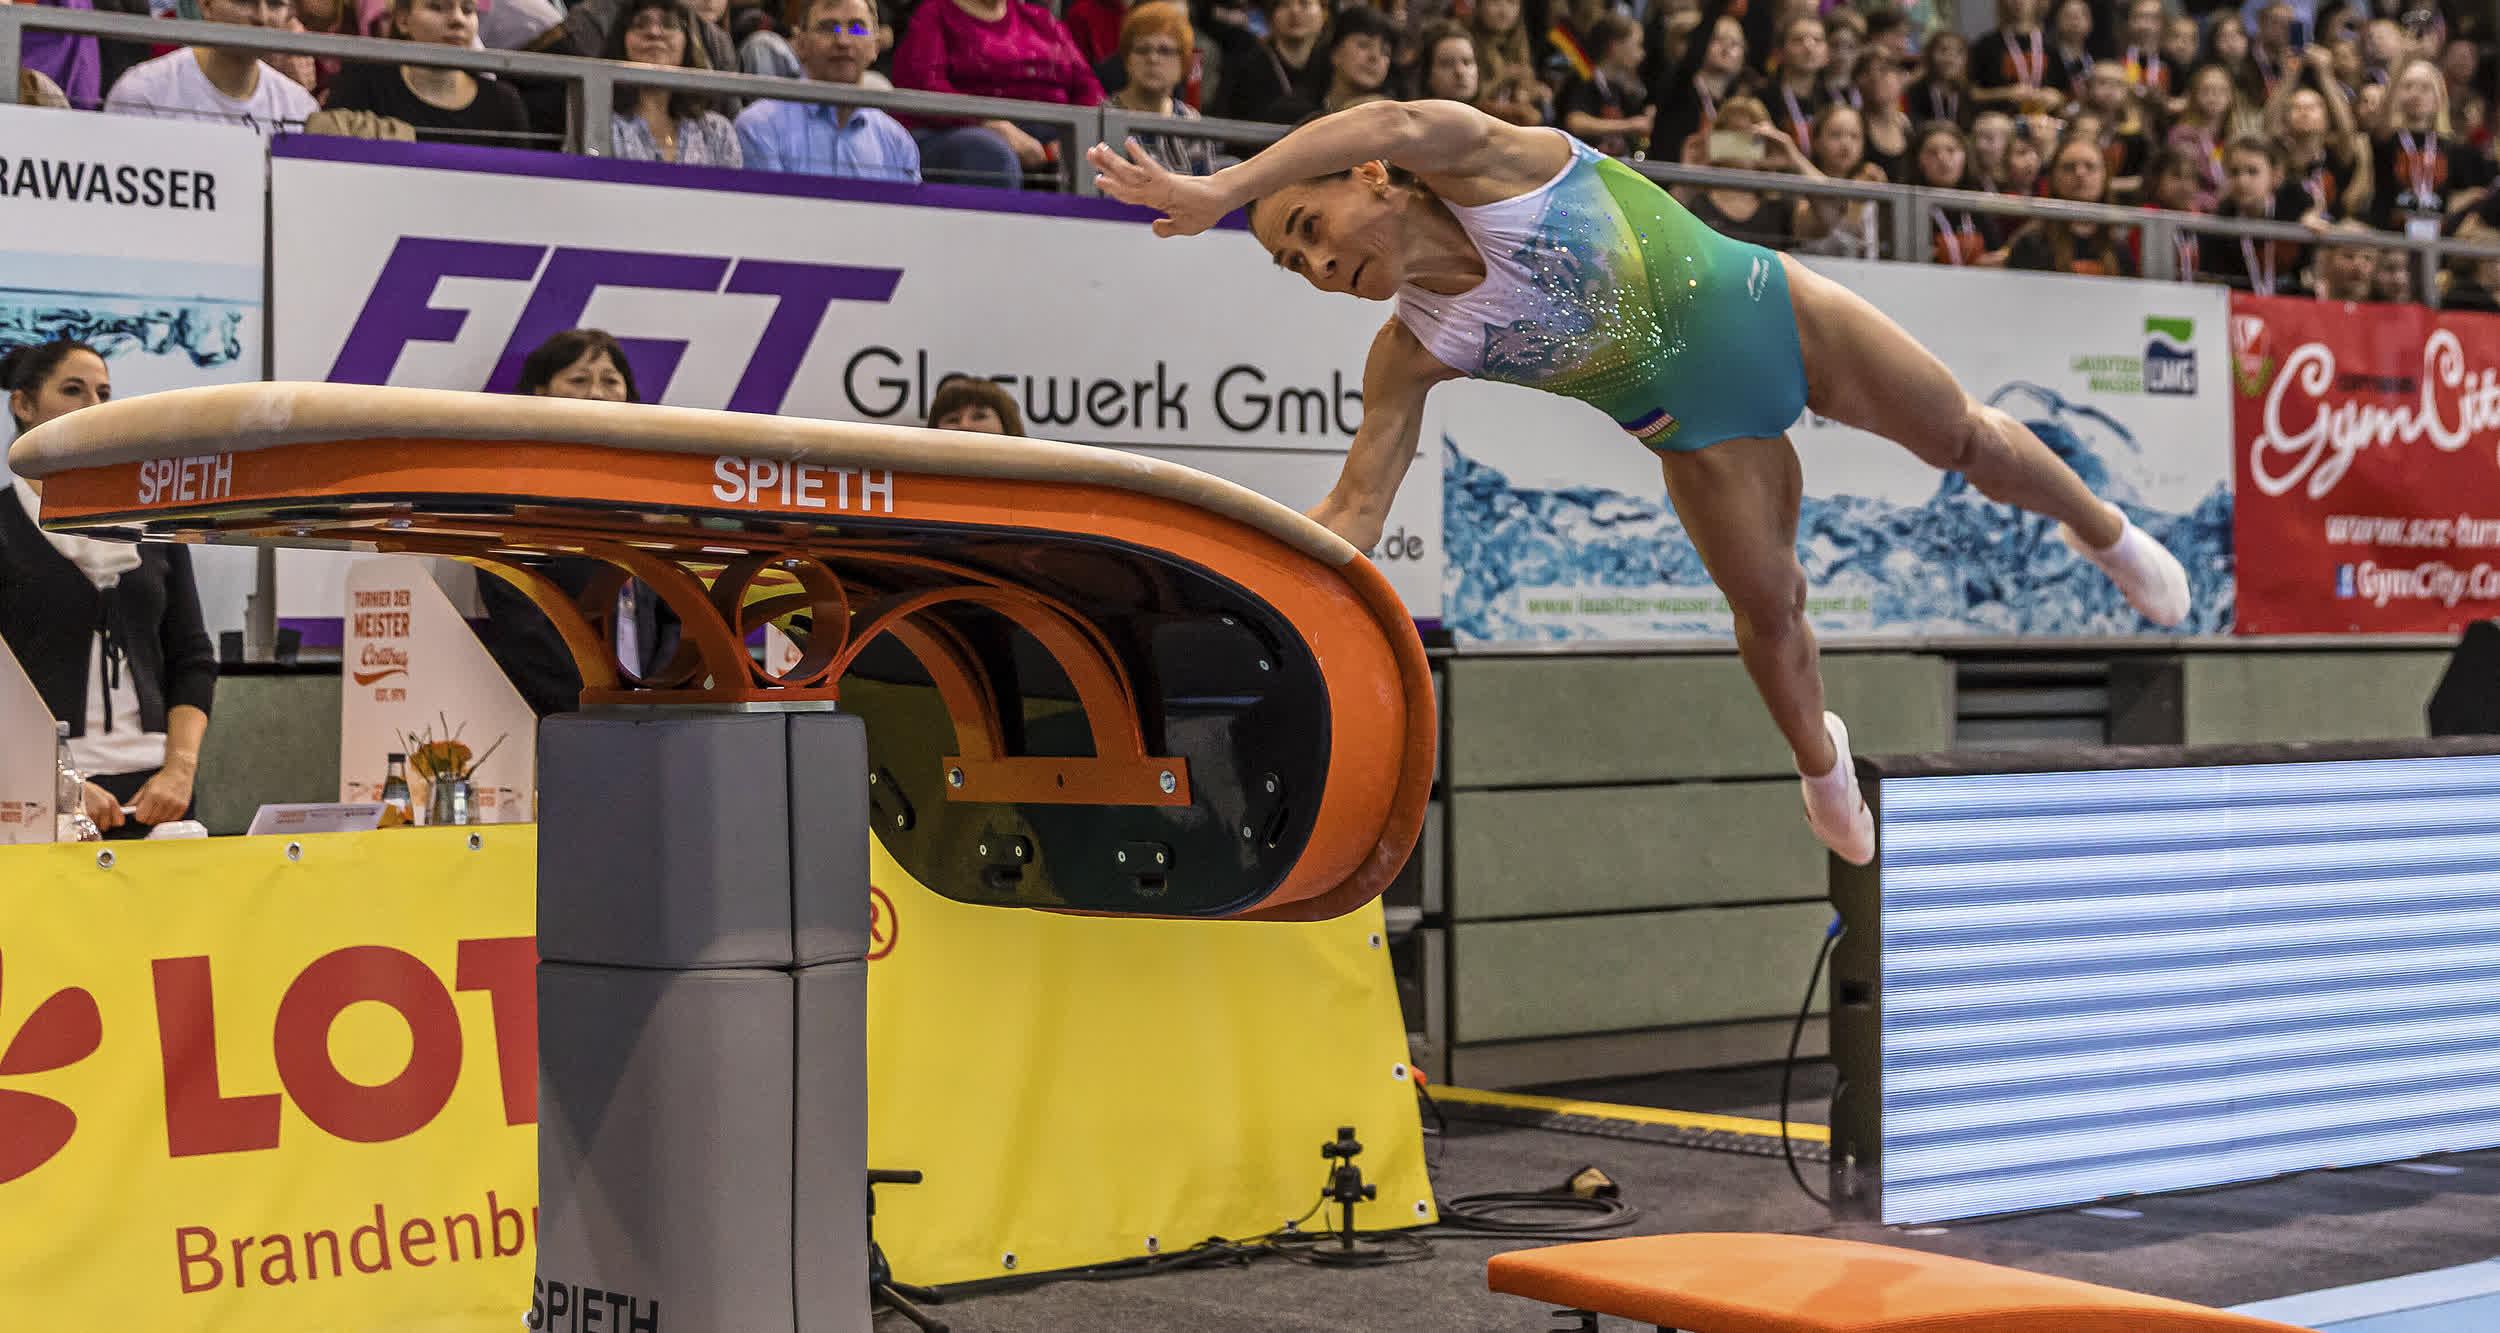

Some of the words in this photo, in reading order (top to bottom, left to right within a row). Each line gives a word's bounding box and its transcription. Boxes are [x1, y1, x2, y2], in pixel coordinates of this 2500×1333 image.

[842, 345, 1190, 429] Glwerk
[2250, 328, 2500, 500] GymCit
[139, 452, 232, 504] SPIETH
[713, 454, 893, 513] SPIETH
[354, 612, 410, 638] MEISTER
[176, 1190, 538, 1294] Brandenb
[529, 1273, 659, 1333] SPIETH
